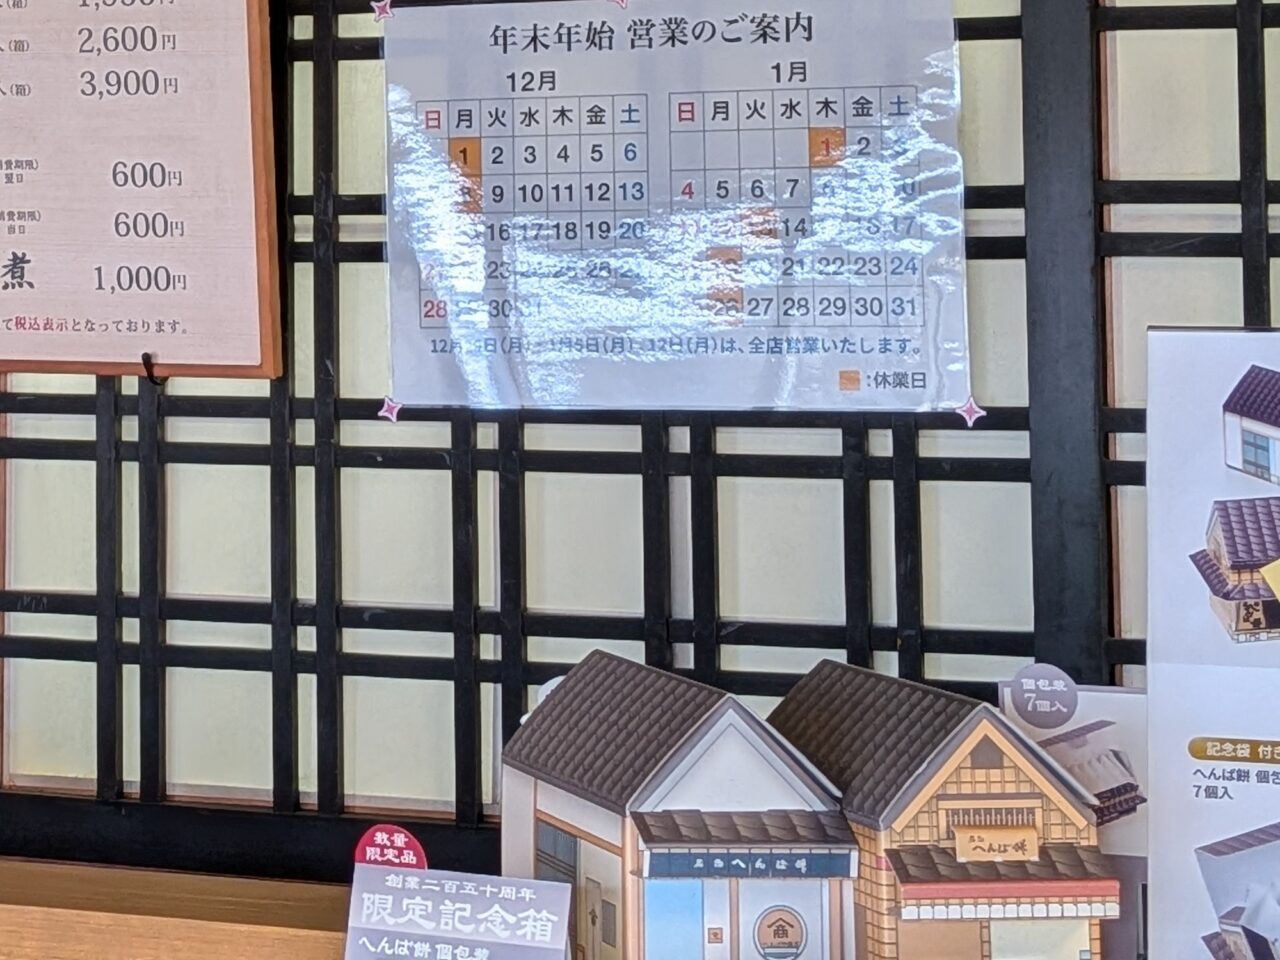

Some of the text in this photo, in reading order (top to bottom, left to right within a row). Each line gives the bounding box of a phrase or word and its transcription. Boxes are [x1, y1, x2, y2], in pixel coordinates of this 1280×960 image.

[78, 25, 176, 56] 2,600円
[489, 11, 813, 54] 年末年始 営業のご案内
[507, 71, 556, 92] 12月
[772, 61, 807, 83] 1月
[80, 70, 178, 101] 3,900円
[425, 103, 640, 130] 日 月 火 水 木 金 土
[678, 95, 911, 122] 日 月 火 水 木 金 土
[459, 143, 637, 166] 1 2 3 4 5 6
[821, 137, 871, 156] 1 2
[112, 161, 182, 188] 600円
[492, 185, 504, 203] 9
[518, 184, 543, 203] 10
[551, 184, 574, 202] 11
[585, 183, 610, 202] 12
[619, 182, 644, 201] 13
[681, 180, 695, 199] 4
[716, 180, 729, 199] 5
[751, 179, 764, 198] 6
[786, 179, 799, 198] 7
[114, 211, 184, 238] 600円
[487, 224, 511, 241] 16
[552, 222, 578, 240] 18
[586, 222, 611, 240] 19
[619, 221, 645, 239] 20
[782, 218, 807, 237] 14
[487, 261, 511, 280] 23
[782, 257, 805, 276] 21
[818, 257, 844, 276] 22
[854, 257, 881, 276] 23
[890, 257, 917, 276] 24
[94, 265, 186, 294] 1,000円
[423, 300, 448, 318] 28
[489, 300, 513, 318] 30
[747, 298, 773, 317] 27
[783, 298, 810, 317] 28
[819, 298, 846, 317] 29
[855, 298, 883, 317] 30
[891, 298, 917, 317] 31
[1024, 694, 1068, 713] 7個入
[1206, 741, 1251, 758] 記念袋
[1192, 767, 1251, 783] へんば餅
[1192, 784, 1234, 800] 7個入
[374, 831, 409, 849] 数量
[365, 847, 417, 865] 限定品
[385, 874, 537, 901] 創業二百五十周年
[361, 892, 560, 943] 限定記念箱
[358, 935, 431, 958] へんば餅
